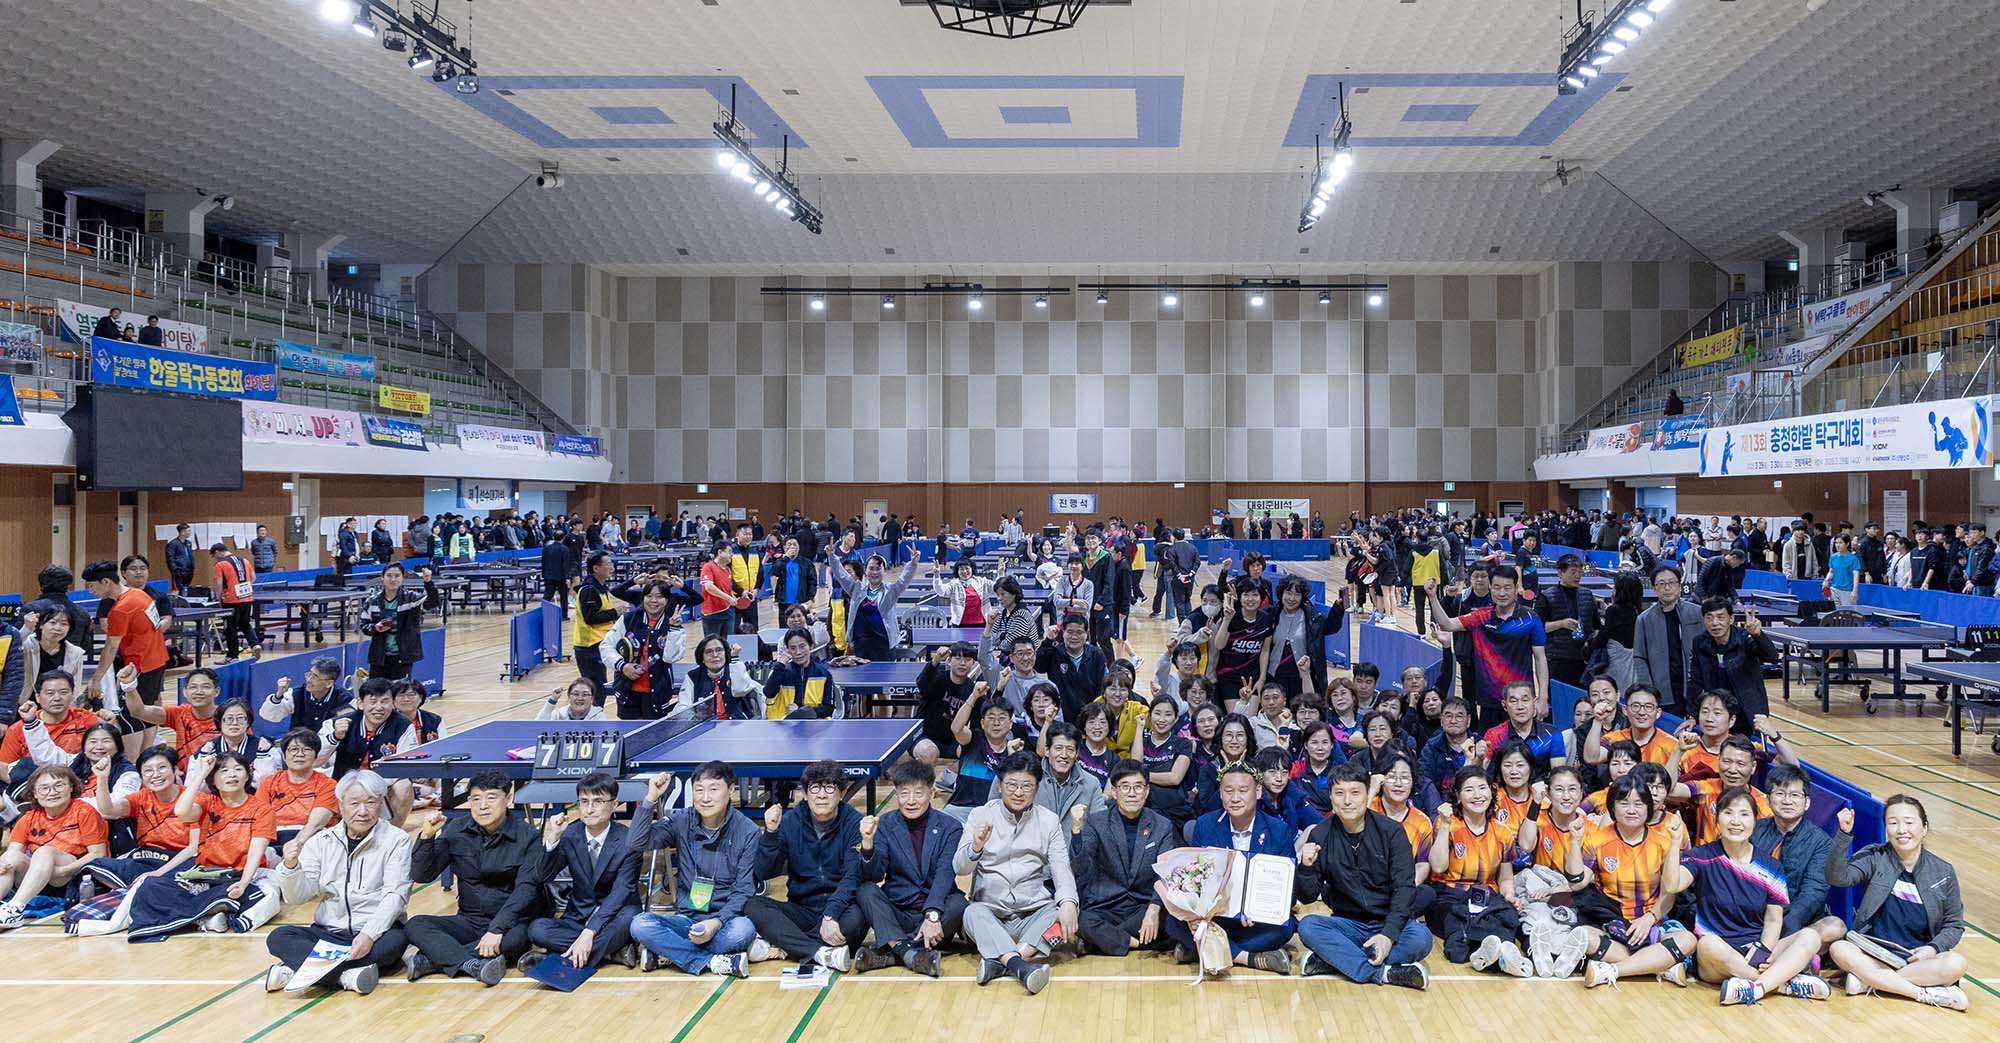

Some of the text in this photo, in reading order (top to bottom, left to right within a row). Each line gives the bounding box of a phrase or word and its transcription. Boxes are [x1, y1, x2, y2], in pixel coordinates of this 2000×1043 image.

[149, 357, 245, 394] 한울탁구동호회
[1741, 418, 1864, 453] 제13회 충청한밭 탁구대회
[1059, 498, 1088, 509] 진행석
[1247, 500, 1292, 511] 대회준비석
[541, 744, 556, 767] 7
[601, 743, 616, 766] 7
[557, 767, 592, 775] XIOM
